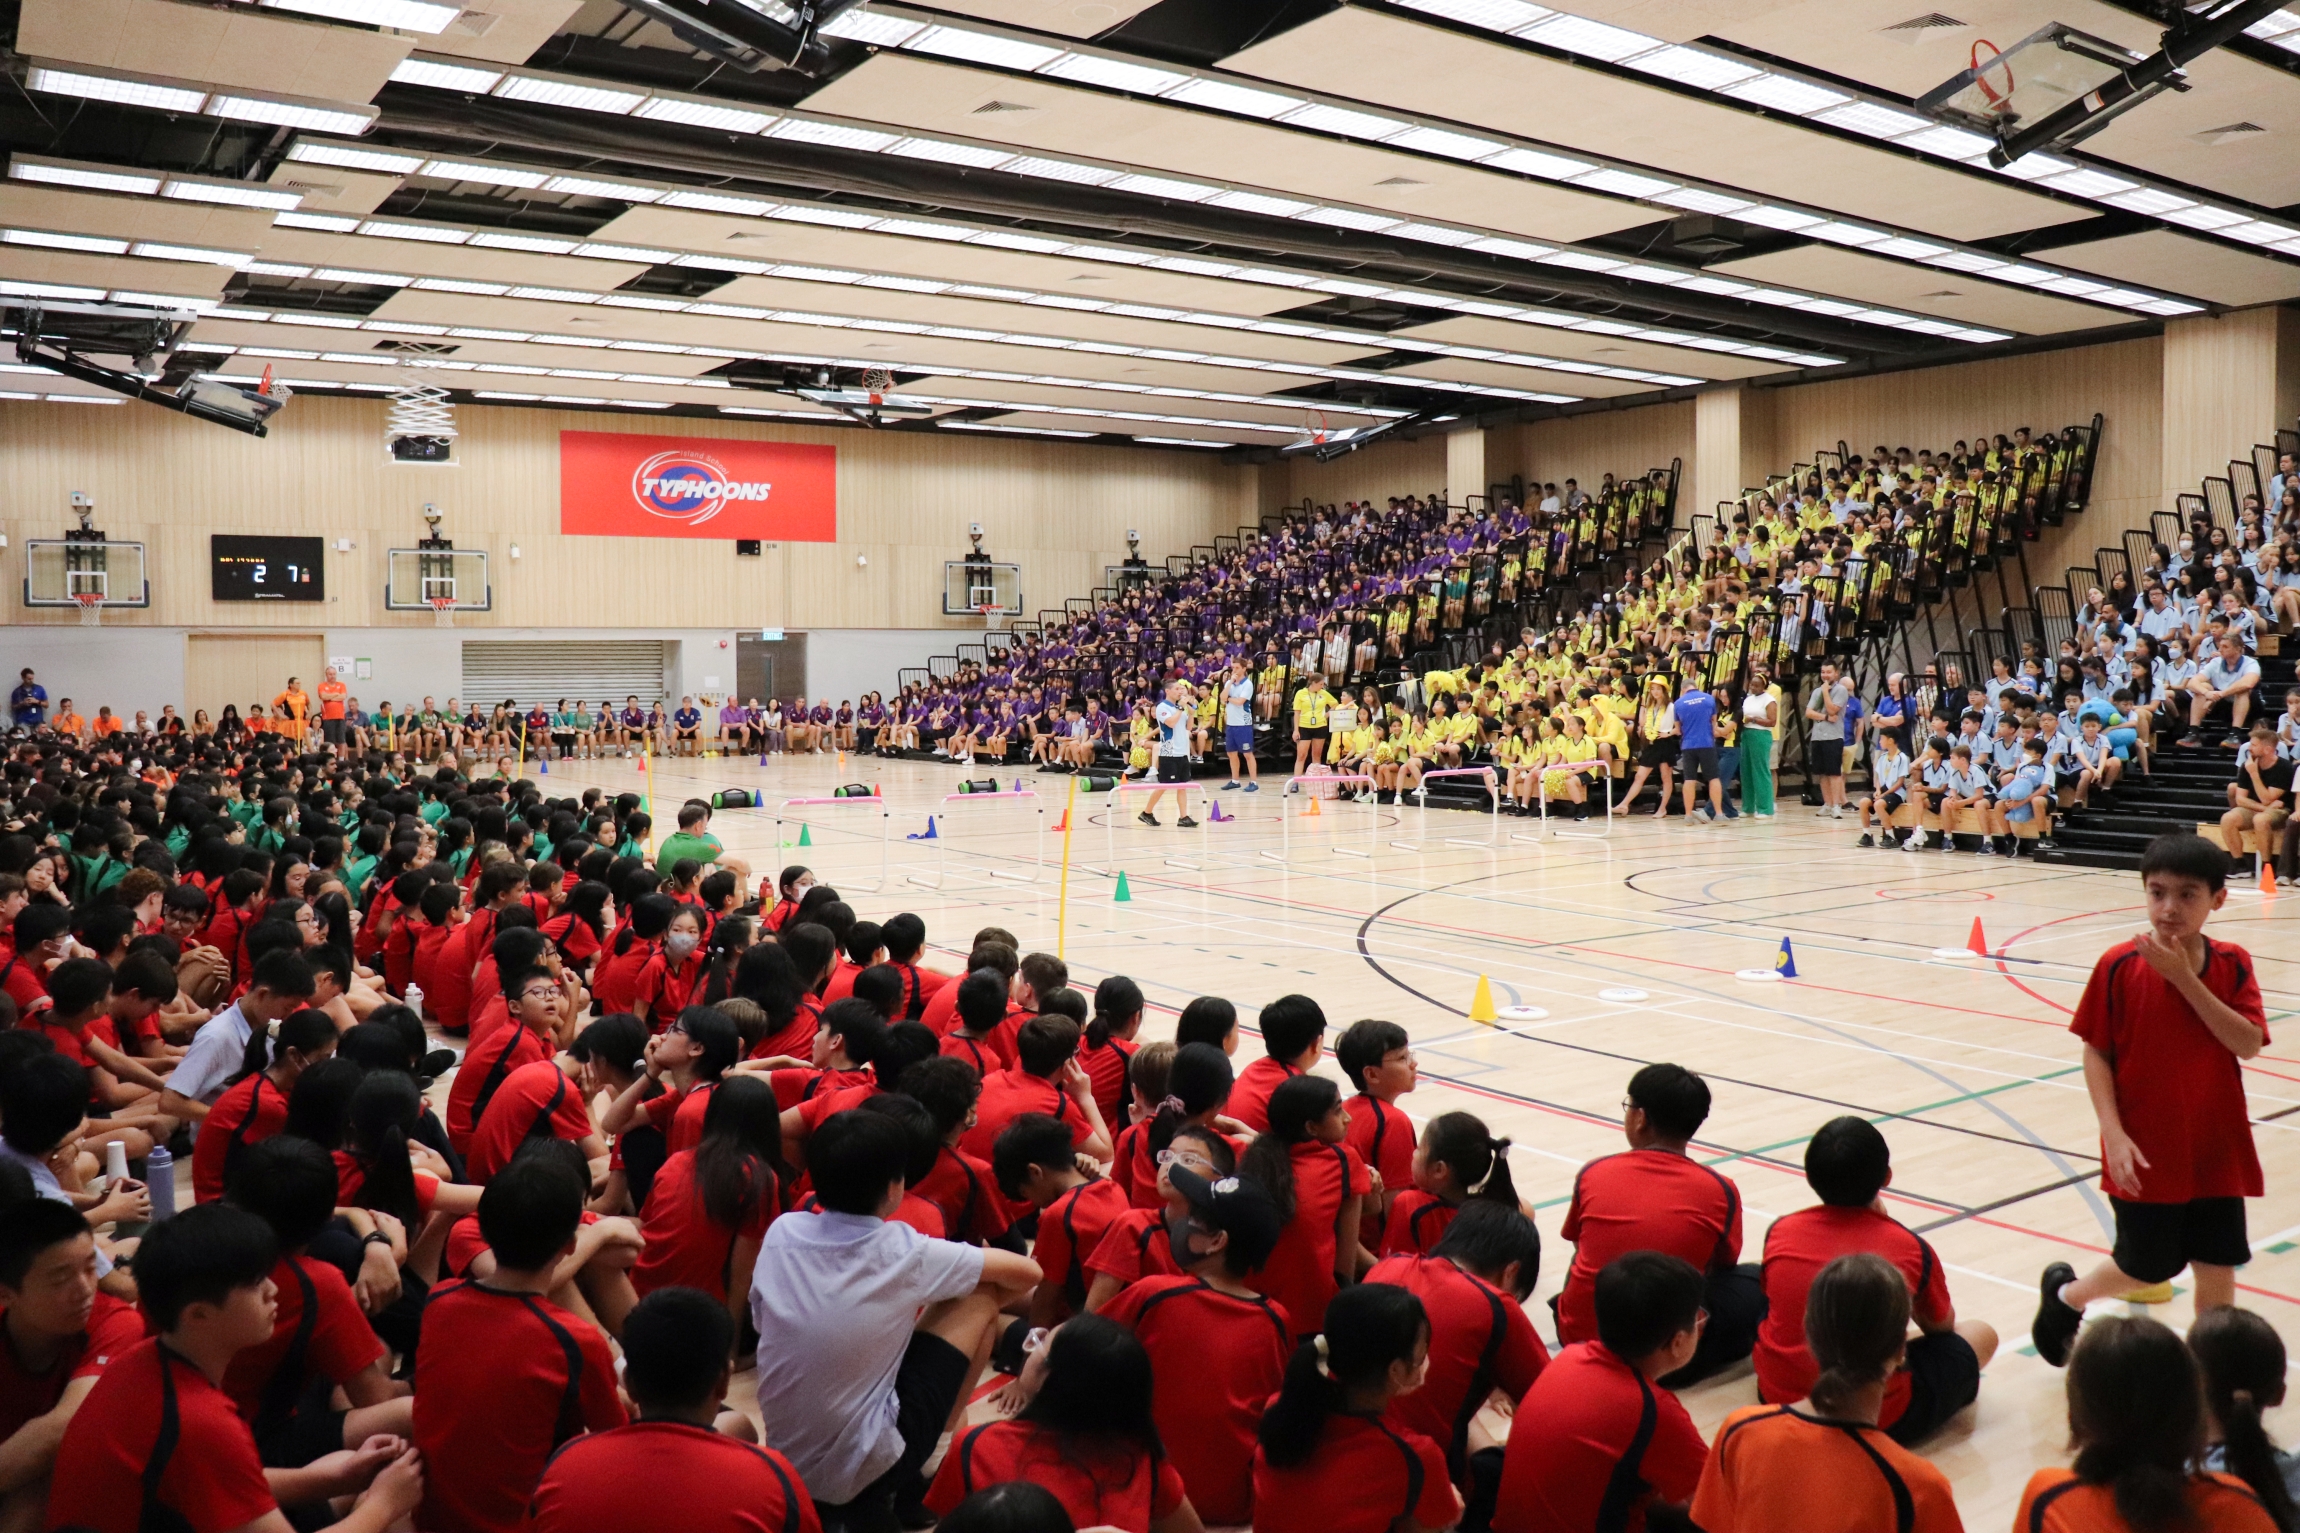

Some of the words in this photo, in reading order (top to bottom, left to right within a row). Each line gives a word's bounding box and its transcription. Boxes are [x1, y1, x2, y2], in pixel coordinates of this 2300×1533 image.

[680, 450, 705, 460] Island
[706, 455, 730, 475] School
[642, 478, 771, 501] TYPHOONS
